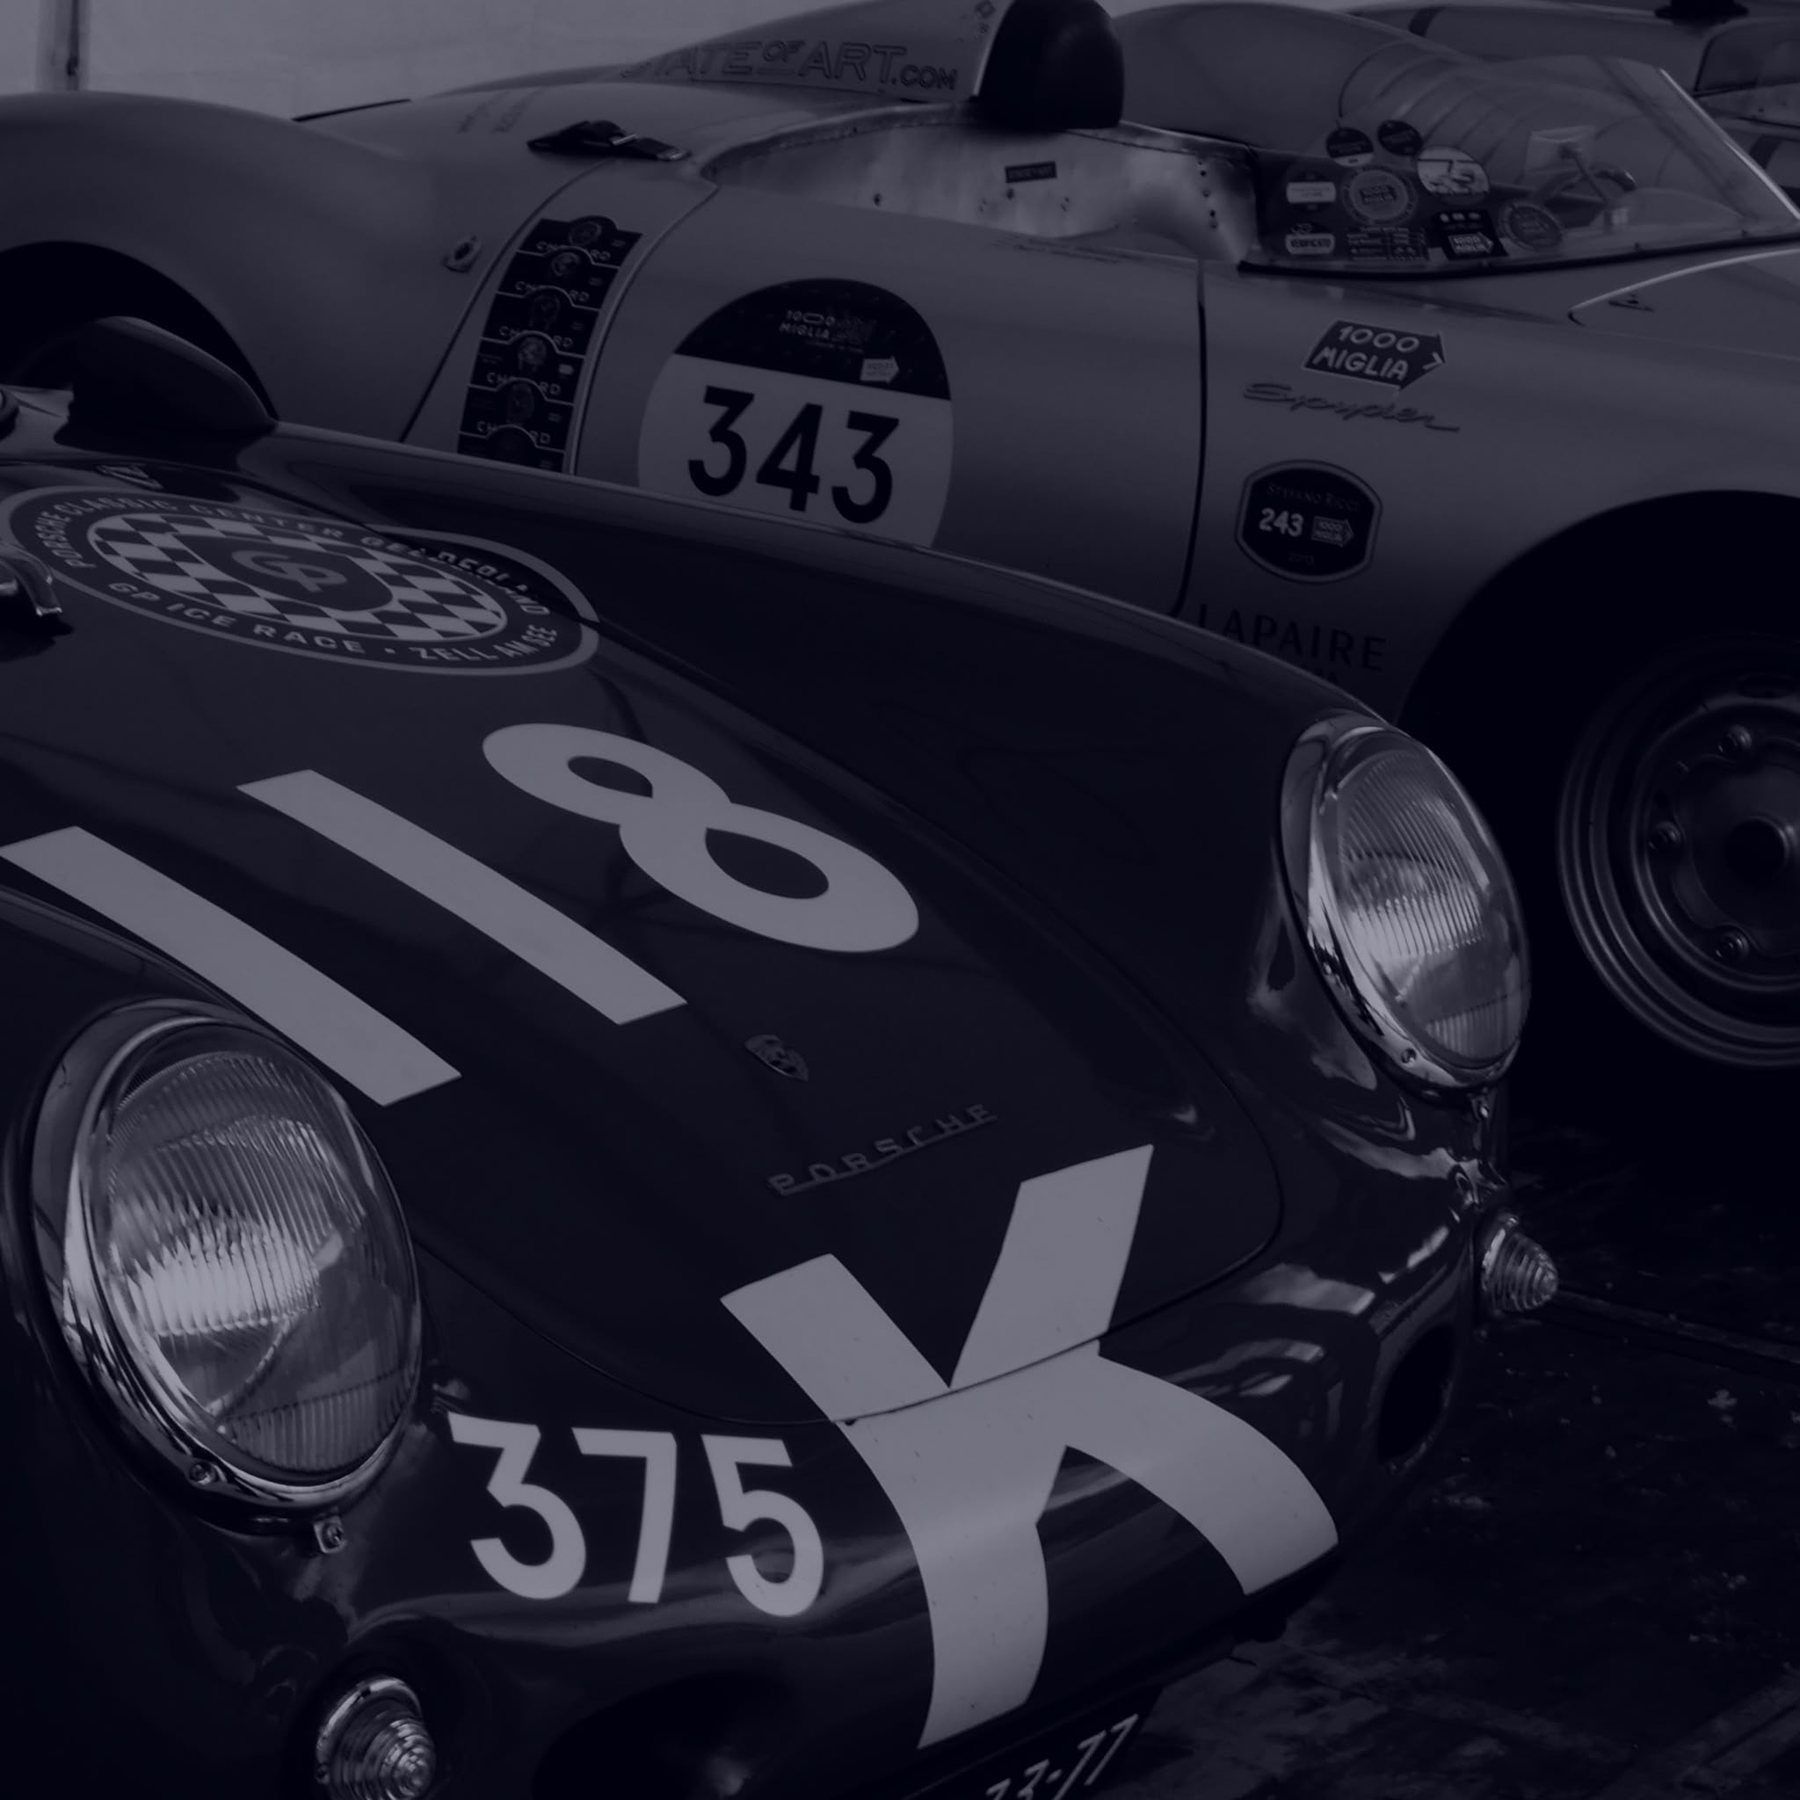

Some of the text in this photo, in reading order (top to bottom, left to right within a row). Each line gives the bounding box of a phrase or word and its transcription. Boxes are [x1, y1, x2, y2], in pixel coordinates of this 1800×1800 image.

[620, 41, 763, 79] ATE
[762, 40, 806, 63] OF
[1338, 325, 1421, 353] 1000
[1312, 346, 1409, 381] MIGLIA
[1242, 382, 1462, 433] Spyder
[688, 384, 901, 525] 343
[53, 496, 180, 516] CLASSIC
[188, 503, 346, 539] CENTER
[1258, 507, 1305, 538] 243
[34, 510, 98, 570] PORSCHE
[107, 580, 367, 654] GP ICE RACE
[407, 623, 559, 661] ZELL AM SEE
[0, 722, 920, 1107] 118
[766, 1102, 999, 1197] PORSCHE
[447, 1411, 825, 1618] 375
